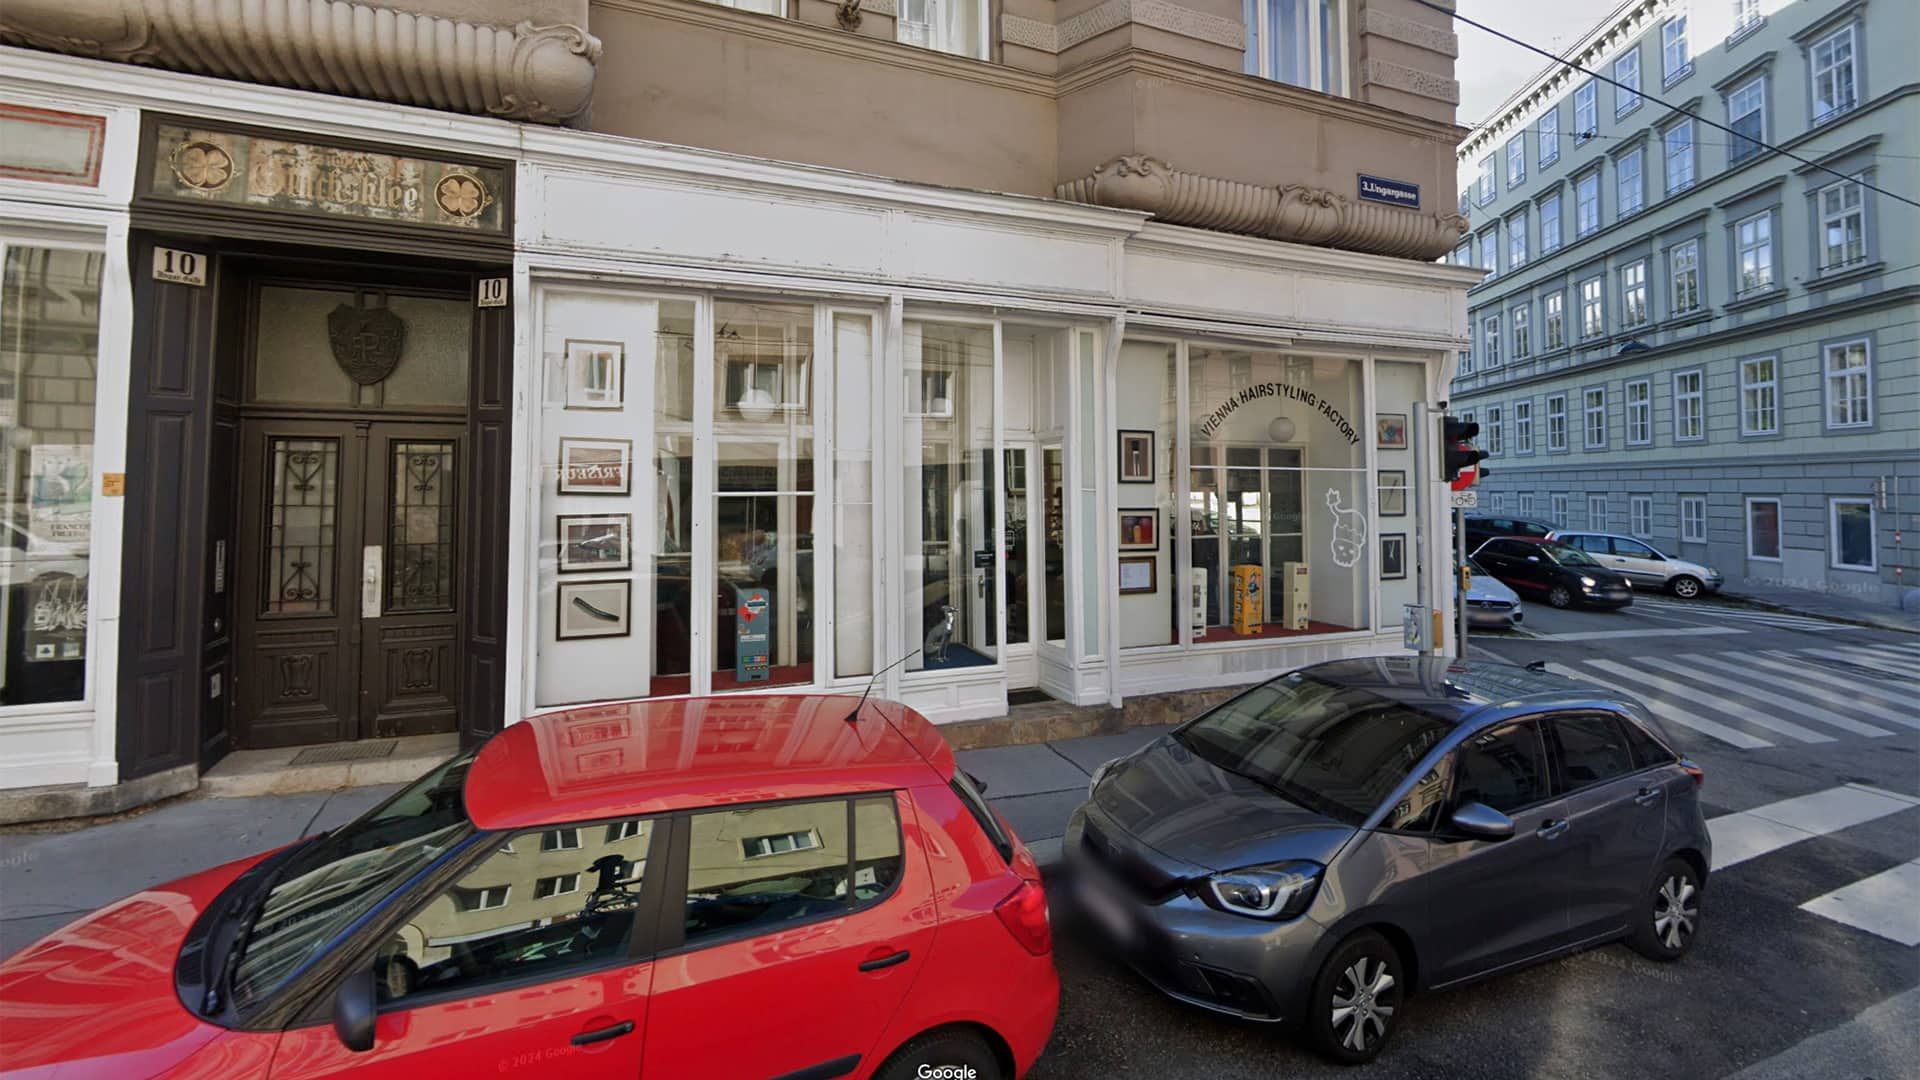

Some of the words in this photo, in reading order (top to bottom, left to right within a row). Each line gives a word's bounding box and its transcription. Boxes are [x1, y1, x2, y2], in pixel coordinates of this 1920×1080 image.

[164, 250, 195, 275] 10
[484, 279, 501, 300] 10
[1201, 395, 1239, 437] VIENNA
[1239, 382, 1316, 407] HAIRSTYLING
[1317, 399, 1360, 446] FACTORY
